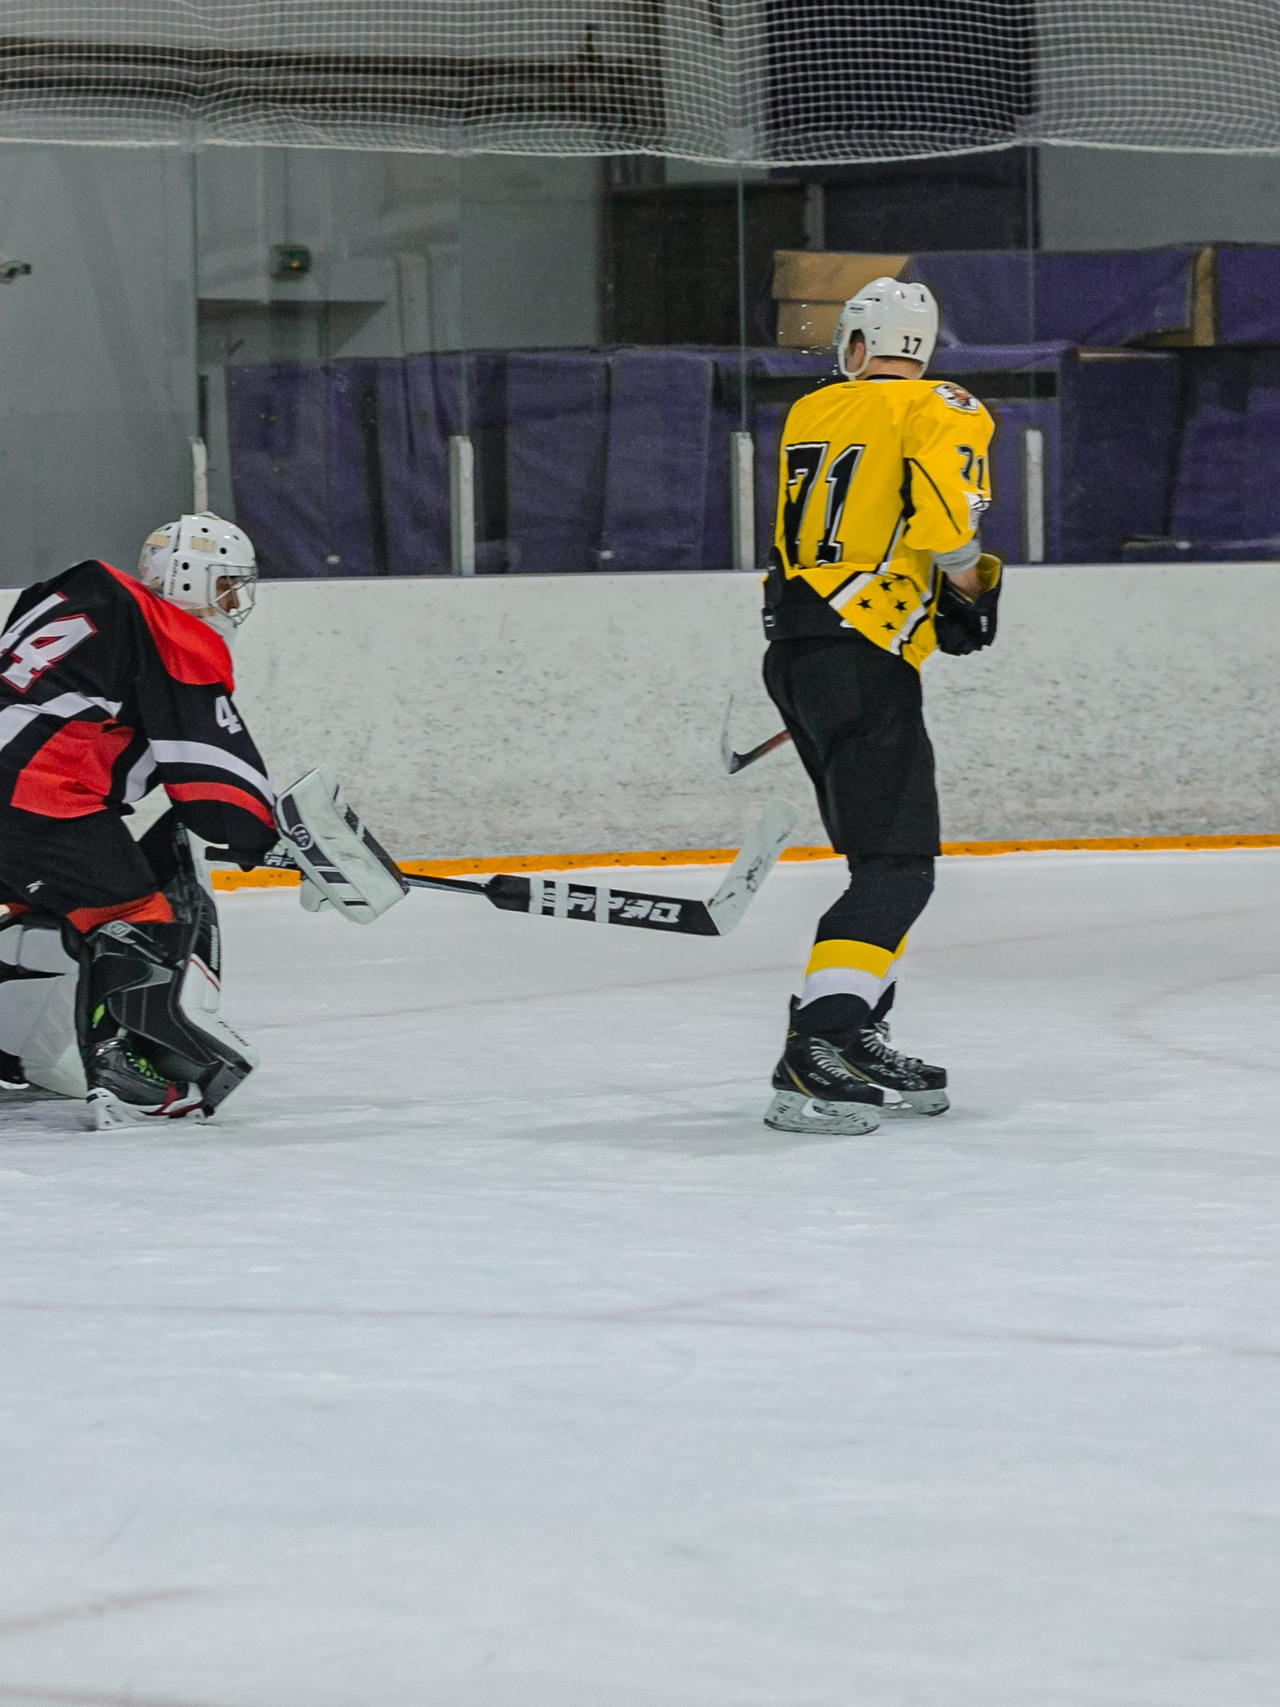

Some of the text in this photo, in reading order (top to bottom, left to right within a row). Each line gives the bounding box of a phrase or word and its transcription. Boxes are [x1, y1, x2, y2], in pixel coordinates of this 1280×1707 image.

[901, 335, 922, 355] 17
[955, 444, 985, 491] 71
[784, 441, 867, 570] 71
